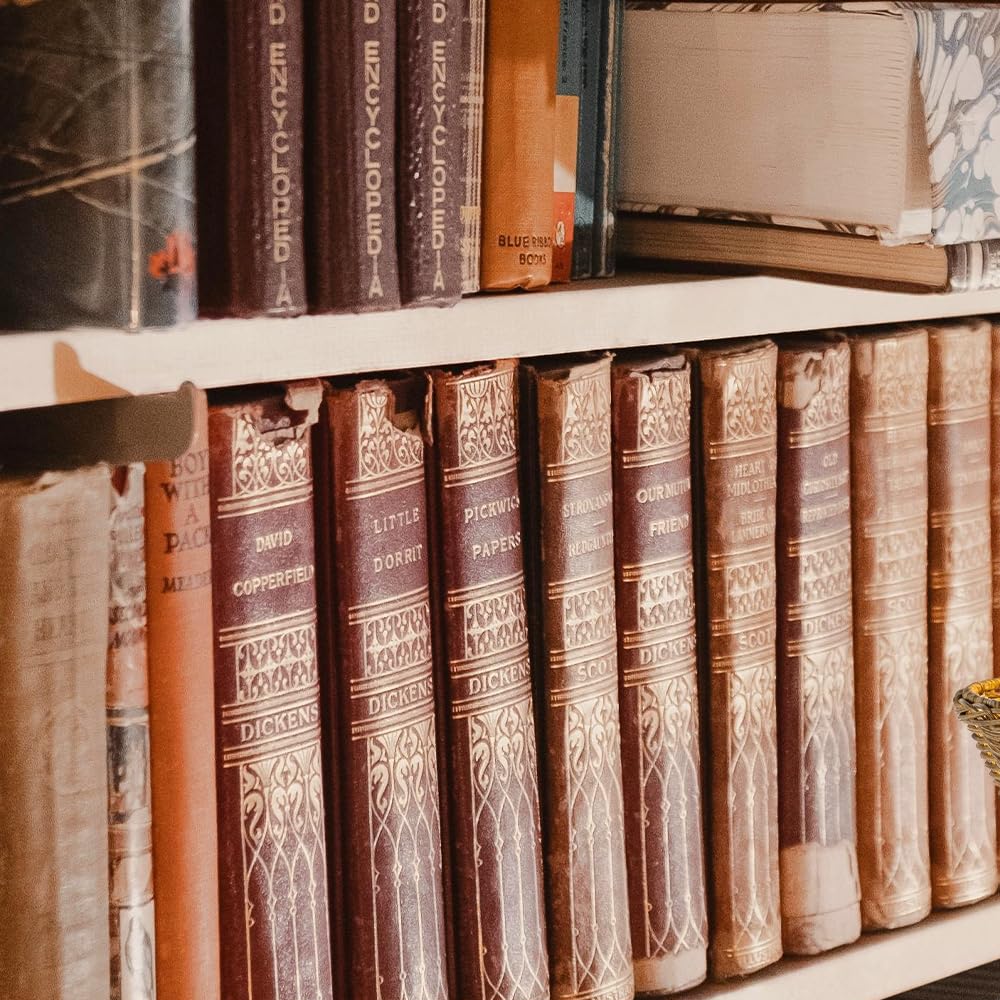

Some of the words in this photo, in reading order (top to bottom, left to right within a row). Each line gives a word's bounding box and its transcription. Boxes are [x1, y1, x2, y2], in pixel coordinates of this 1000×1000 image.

[269, 42, 292, 306] ENCYCLOPEDIA
[363, 41, 385, 298] ENCYCLOPEDIA
[431, 41, 447, 290] ENCYCLOPEDIA
[498, 234, 530, 248] BLUE
[532, 236, 552, 248] RIBBO
[519, 253, 547, 265] BOOKS
[636, 482, 664, 504] OUR
[184, 502, 200, 526] A
[373, 507, 420, 534] LITTLE
[256, 529, 293, 553] DAVID
[472, 531, 521, 560] PAPERS
[373, 543, 423, 573] DORRIT
[232, 564, 315, 598] COPPERFIELD
[738, 628, 774, 651] SCOT
[468, 658, 531, 697] DICKENS
[577, 658, 617, 683] SCOT
[367, 676, 433, 716] DICKENS
[240, 702, 319, 743] DICKENS
